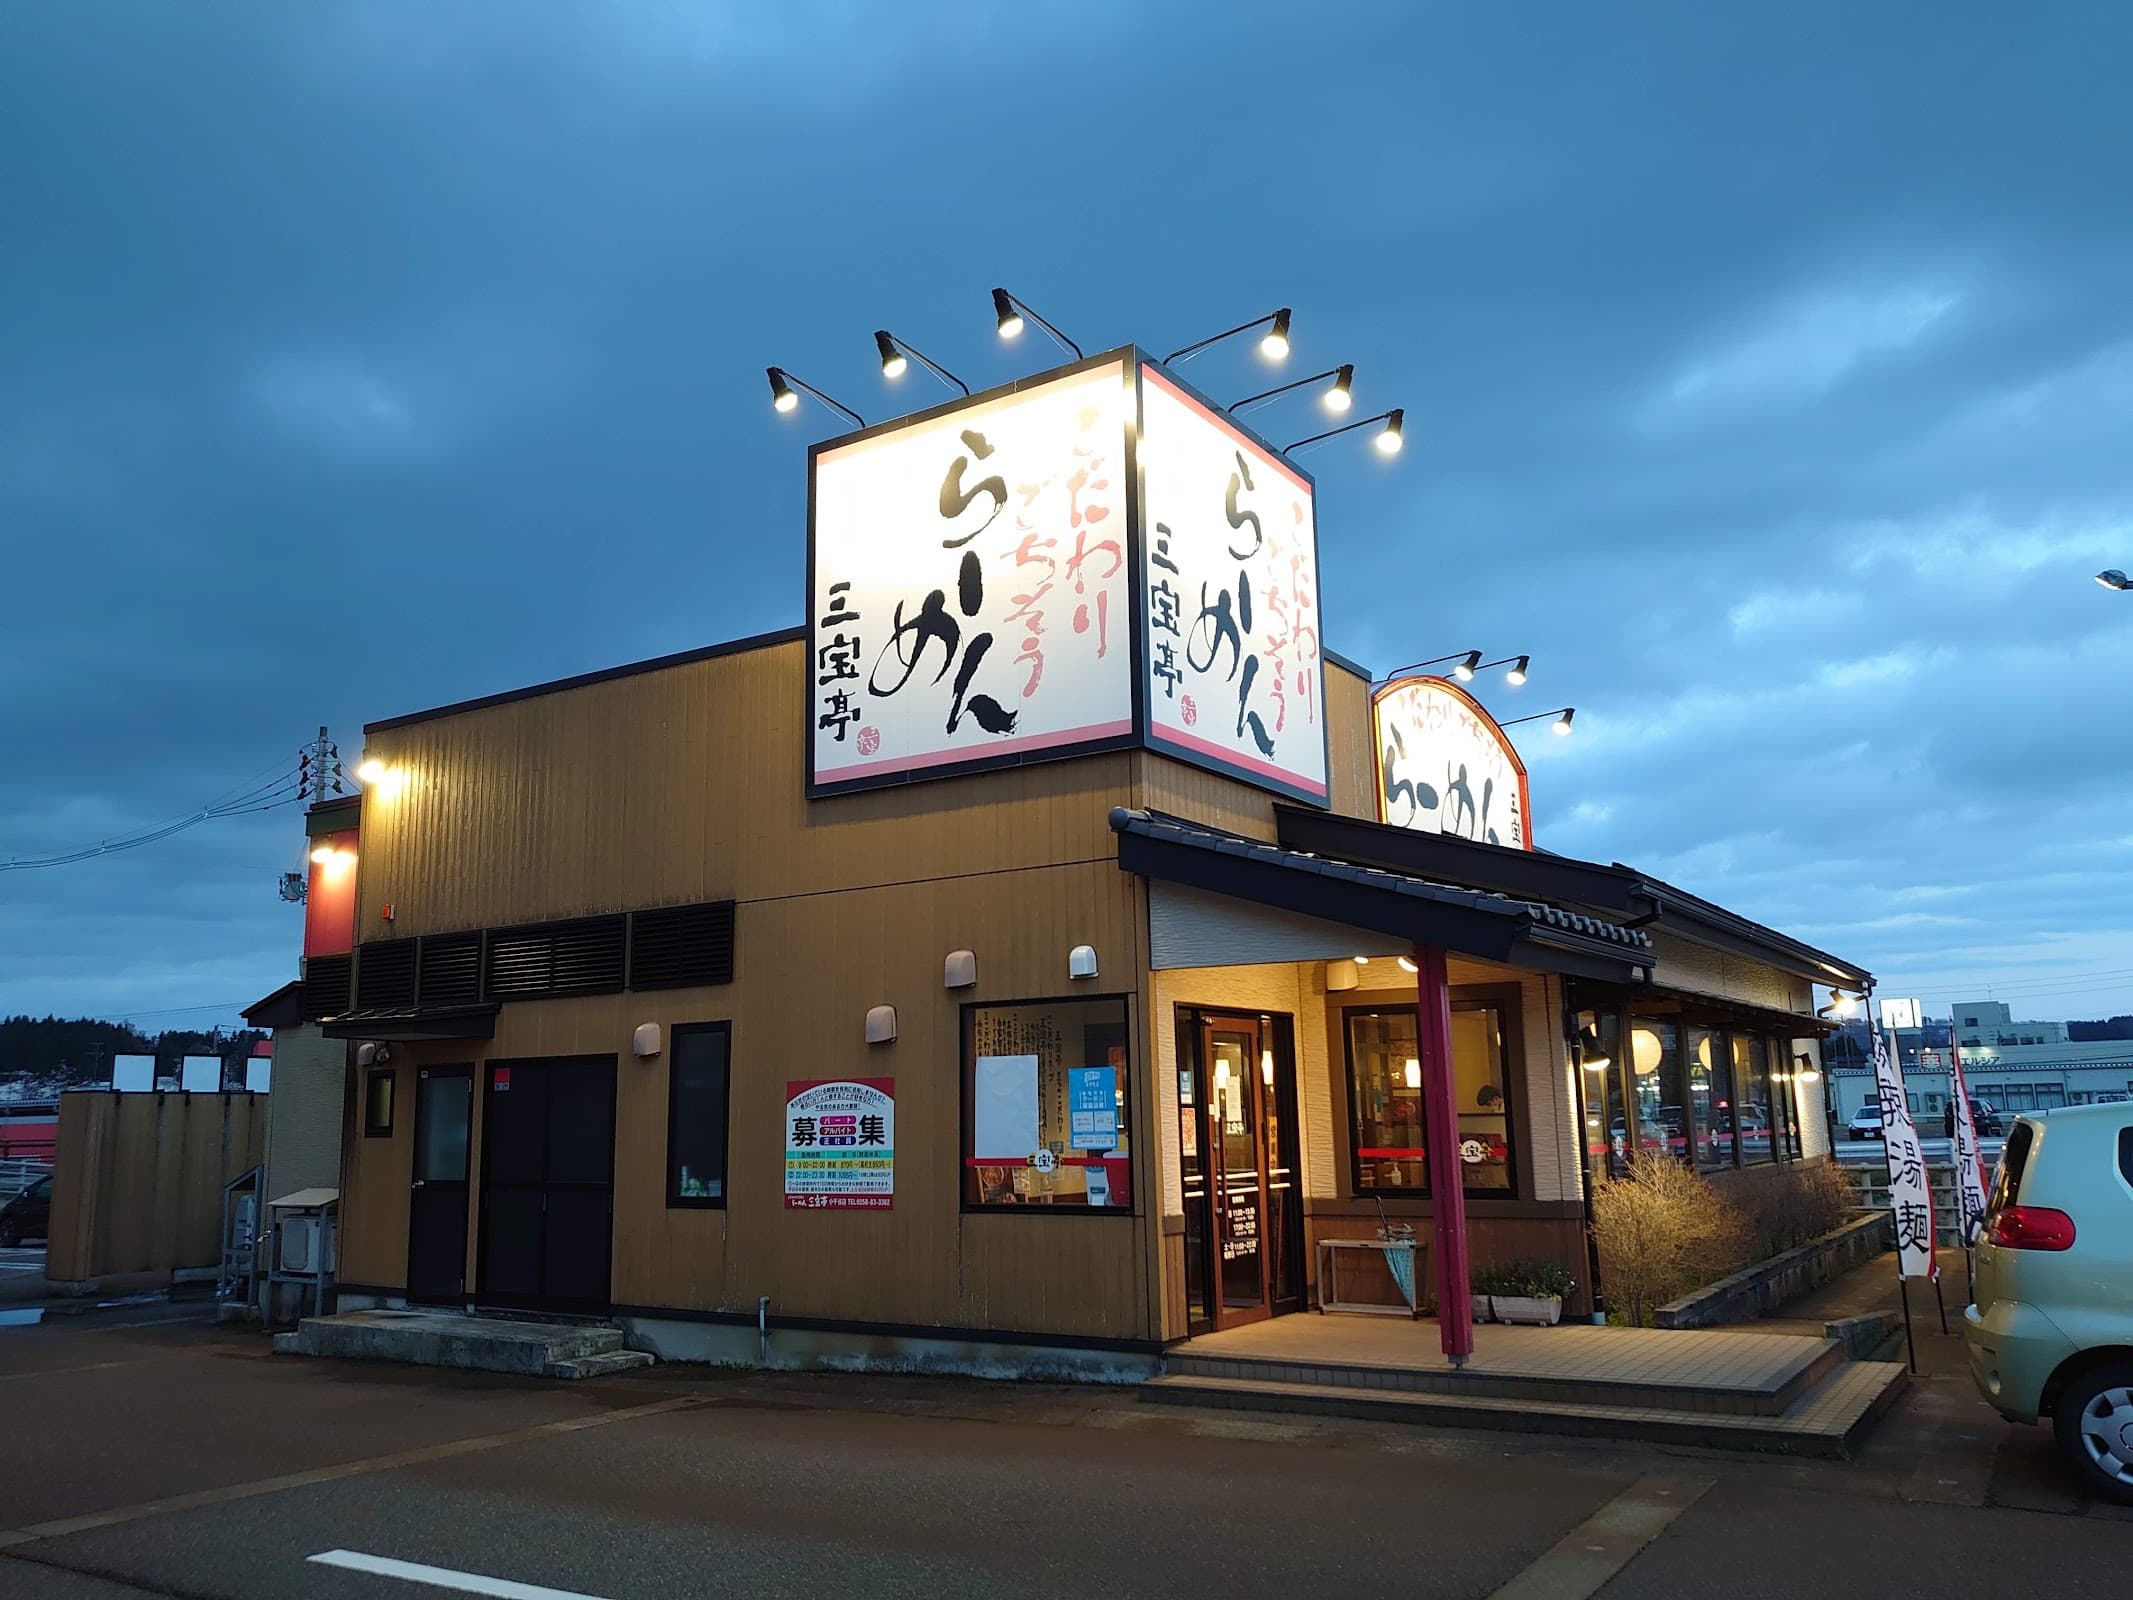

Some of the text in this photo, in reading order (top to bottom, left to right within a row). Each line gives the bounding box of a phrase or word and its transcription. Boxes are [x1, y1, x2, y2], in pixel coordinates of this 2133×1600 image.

[818, 581, 862, 742] 三宝亭
[868, 429, 1018, 736] らーめん
[1151, 523, 1182, 699] 三宝亭
[1186, 450, 1275, 760] らーめん
[791, 1114, 885, 1147] 募 集
[1961, 1056, 2000, 1067] エルシア
